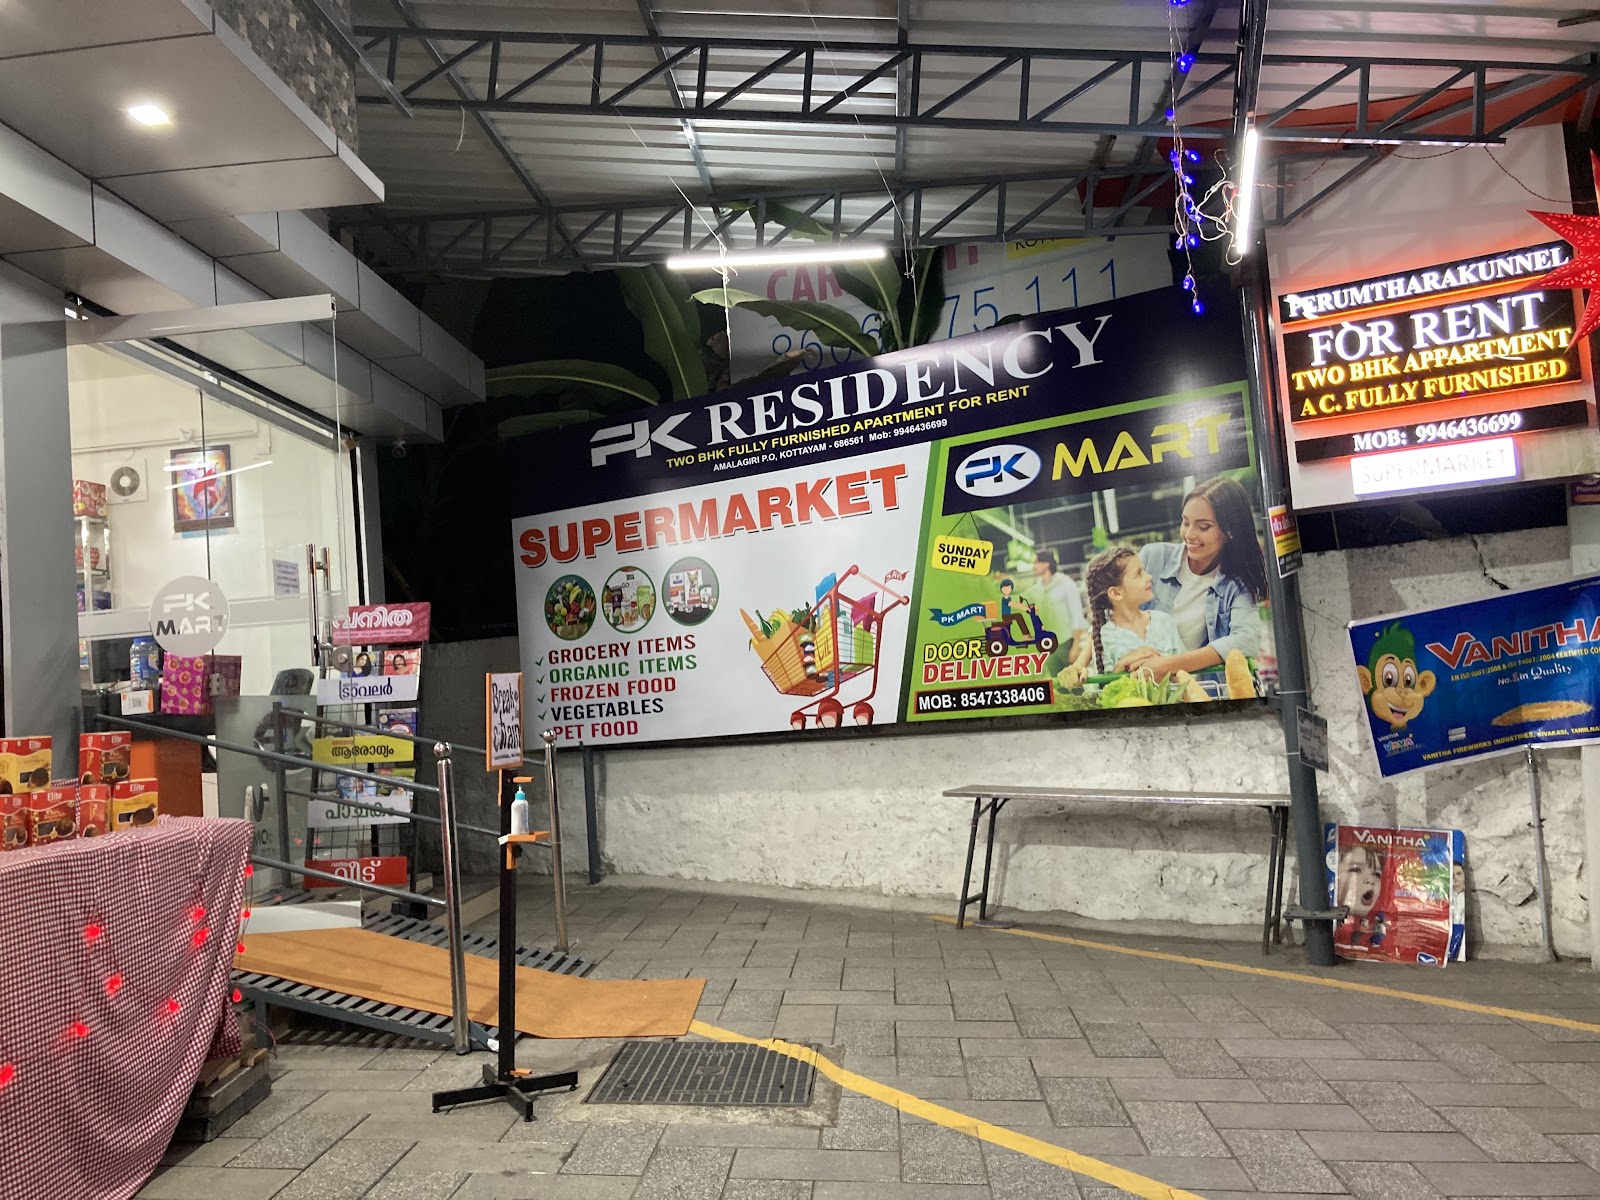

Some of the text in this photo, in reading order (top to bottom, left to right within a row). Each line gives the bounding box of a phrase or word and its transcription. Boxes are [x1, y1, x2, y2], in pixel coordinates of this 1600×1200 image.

[1308, 291, 1545, 367] FOR RENT
[1291, 327, 1573, 391] TWO BHK APPARTMENT
[590, 314, 1113, 467] PK RESIDENCY
[1344, 380, 1418, 410] FULLY
[1423, 358, 1568, 398] FURNISHED
[666, 385, 1030, 469] TWO BHK FULLY FURNISHED APARTMENT FOR RENT
[1352, 411, 1522, 452] MOB: 9946436699
[713, 455, 760, 472] AMALAGIRI
[780, 442, 827, 459] KOTTAYAM
[833, 436, 864, 449] 686561
[869, 430, 892, 442] Mob:
[893, 418, 948, 437] 9946436699
[964, 412, 1232, 488] PK MART
[1360, 448, 1507, 485] SUPERMARKET
[518, 464, 907, 568] SUPERMARKET
[938, 543, 990, 560] SUNDAY
[941, 555, 976, 569] OPEN
[163, 591, 211, 613] PK
[941, 605, 983, 624] PK MART
[155, 614, 226, 636] MART
[333, 606, 413, 629] വനിത
[548, 634, 696, 665] GROCERY ITEMS
[924, 639, 983, 664] DOOR
[550, 654, 697, 684] ORGANIC ITEMS
[922, 652, 1049, 684] DELIVERY
[1530, 662, 1572, 680] Quality
[551, 677, 676, 702] FROZEN FOOD
[918, 686, 1045, 711] MOB: 8547338406
[551, 698, 664, 721] VEGETABLES
[552, 720, 639, 740] PET FOOD
[1422, 749, 1452, 761] VANITHA
[1453, 740, 1492, 755] FIREWORKS
[47, 791, 63, 802] Elite
[129, 783, 145, 792] Elite
[1353, 829, 1427, 847] VANITHA
